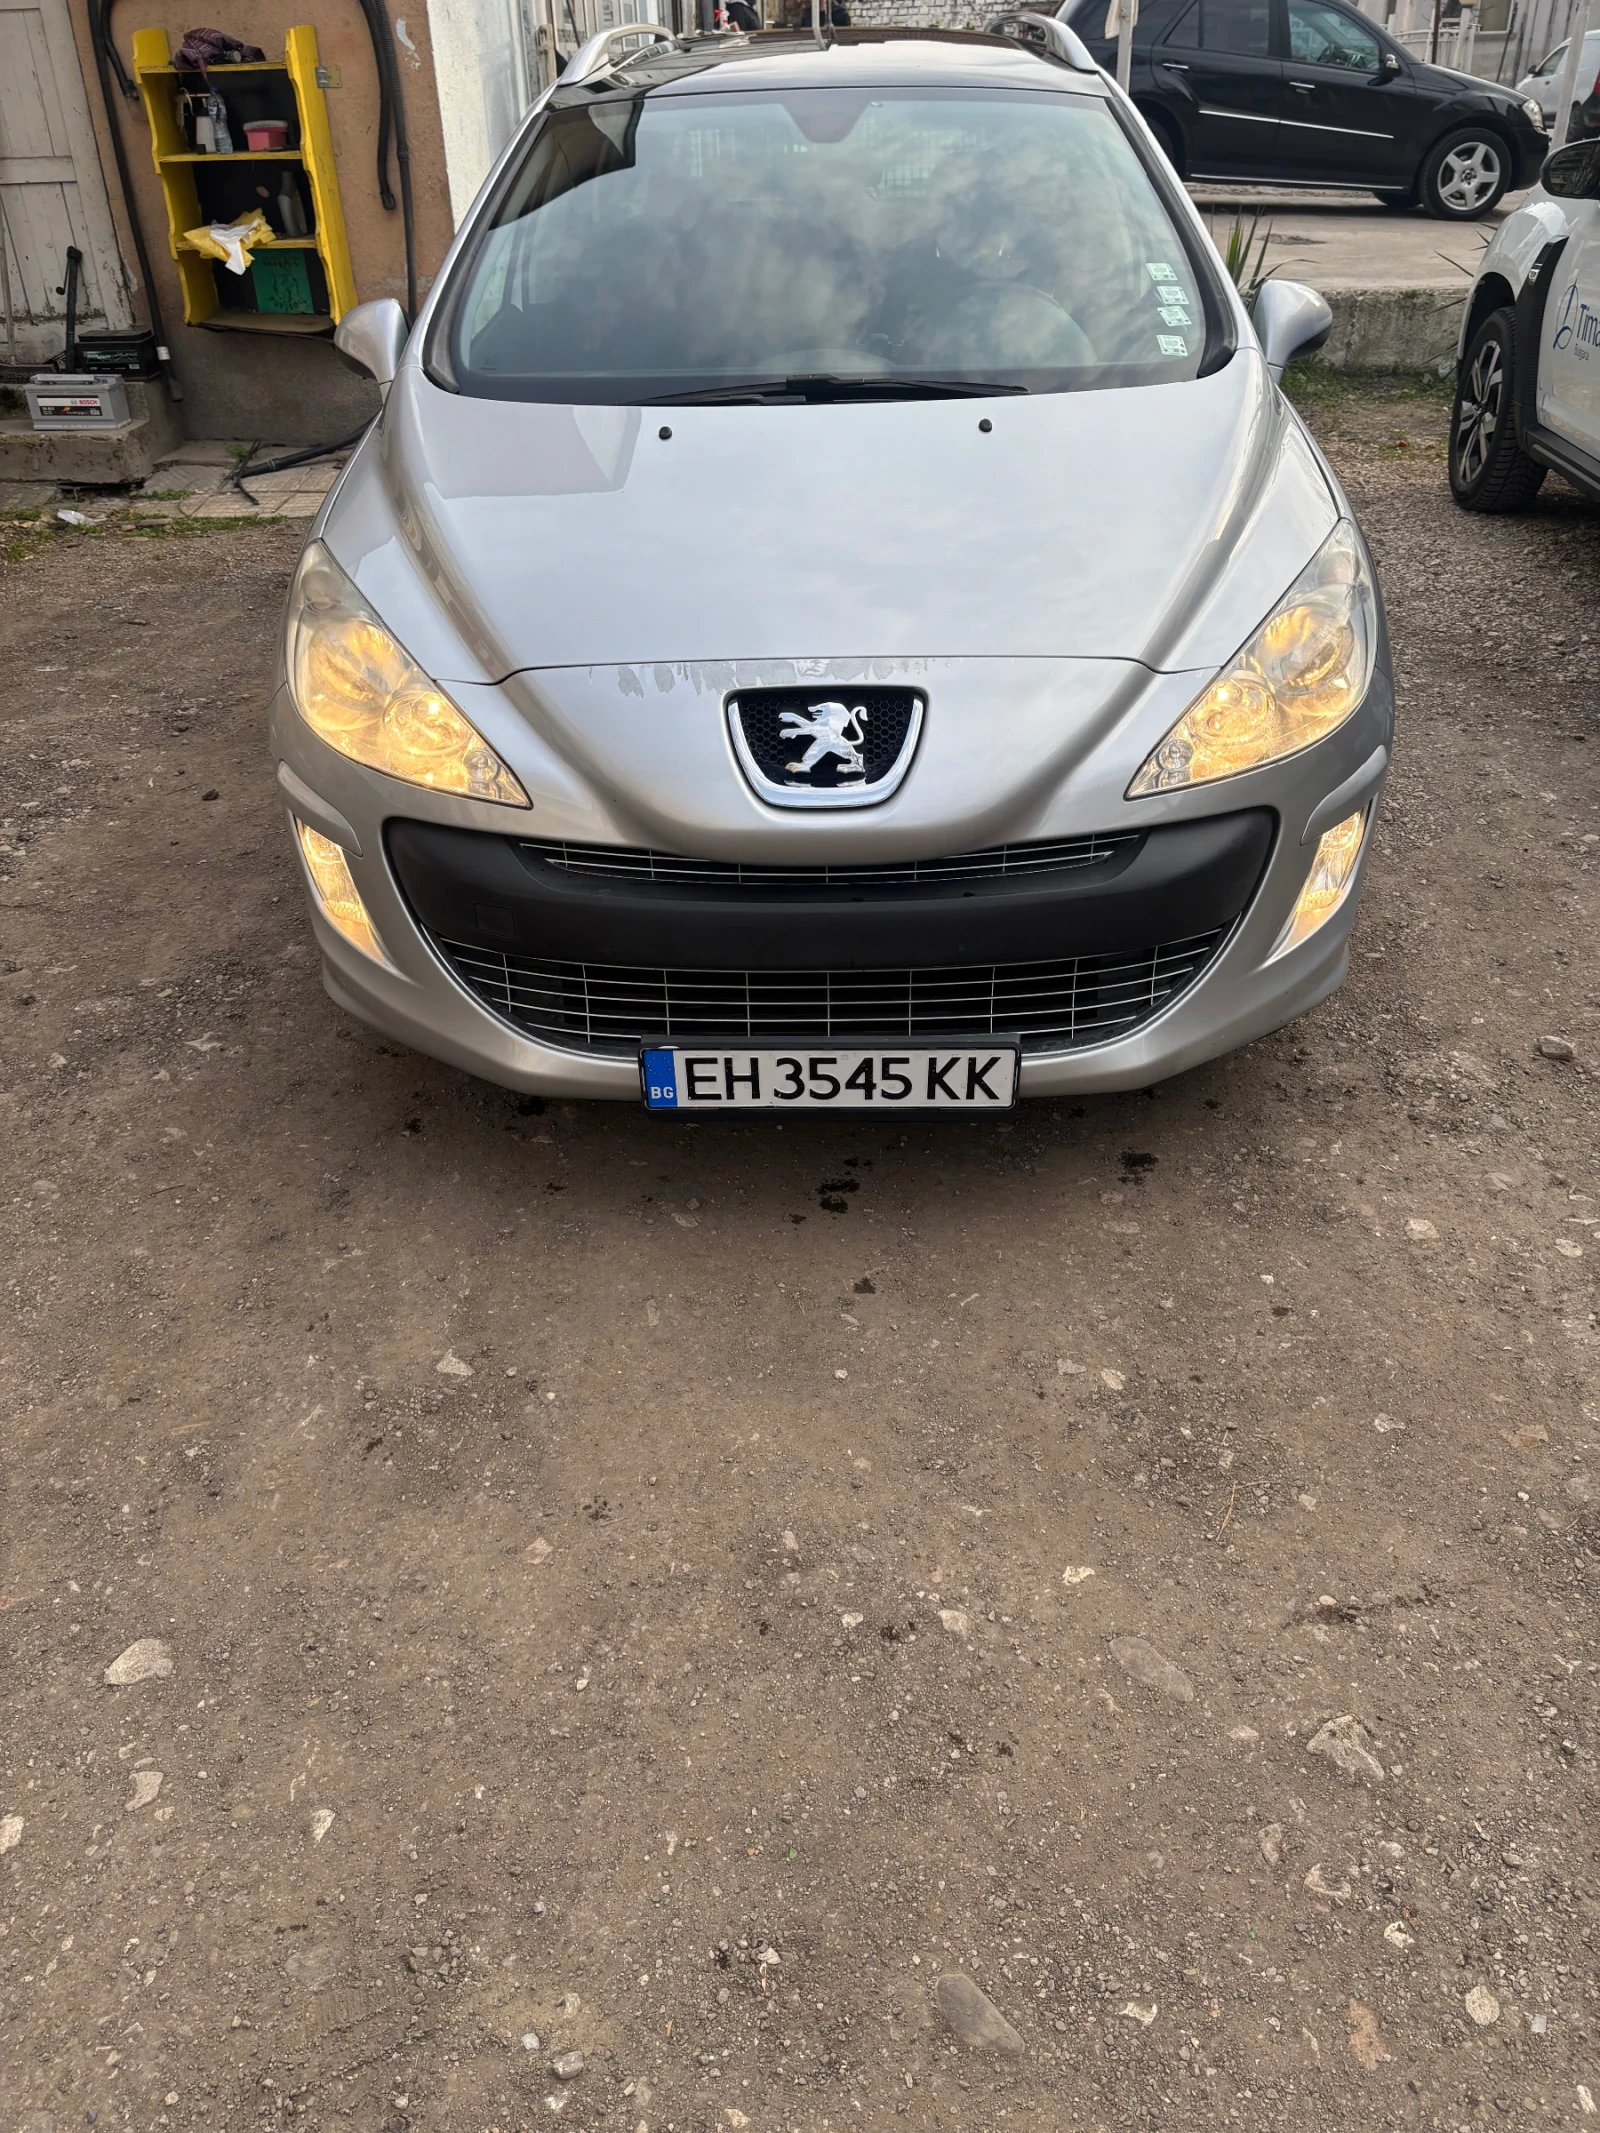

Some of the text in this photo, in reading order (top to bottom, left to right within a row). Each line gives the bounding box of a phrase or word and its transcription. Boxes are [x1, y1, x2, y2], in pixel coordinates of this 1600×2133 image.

[650, 1086, 674, 1099] BG
[684, 1056, 1001, 1101] EH 3545 KK
